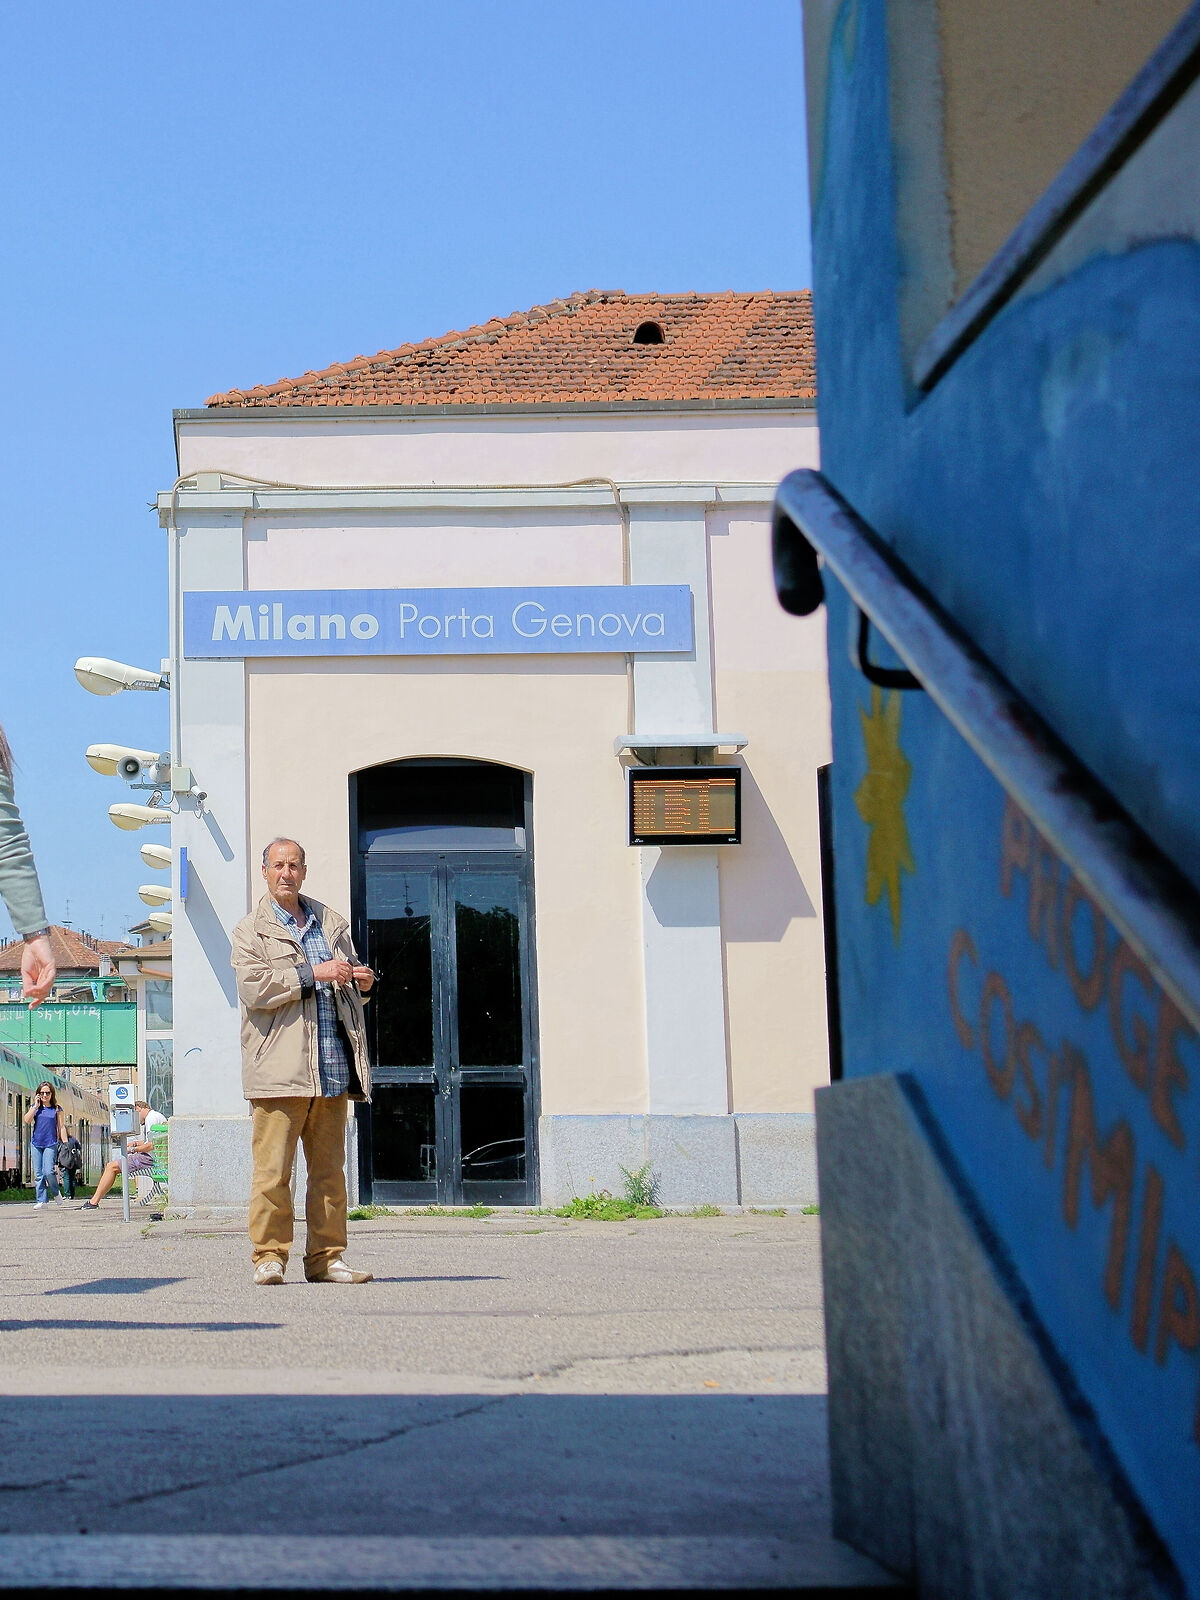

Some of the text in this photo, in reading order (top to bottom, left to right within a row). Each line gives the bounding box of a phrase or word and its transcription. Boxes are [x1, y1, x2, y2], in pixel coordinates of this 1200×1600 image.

[211, 601, 665, 641] Milano Porta Genova
